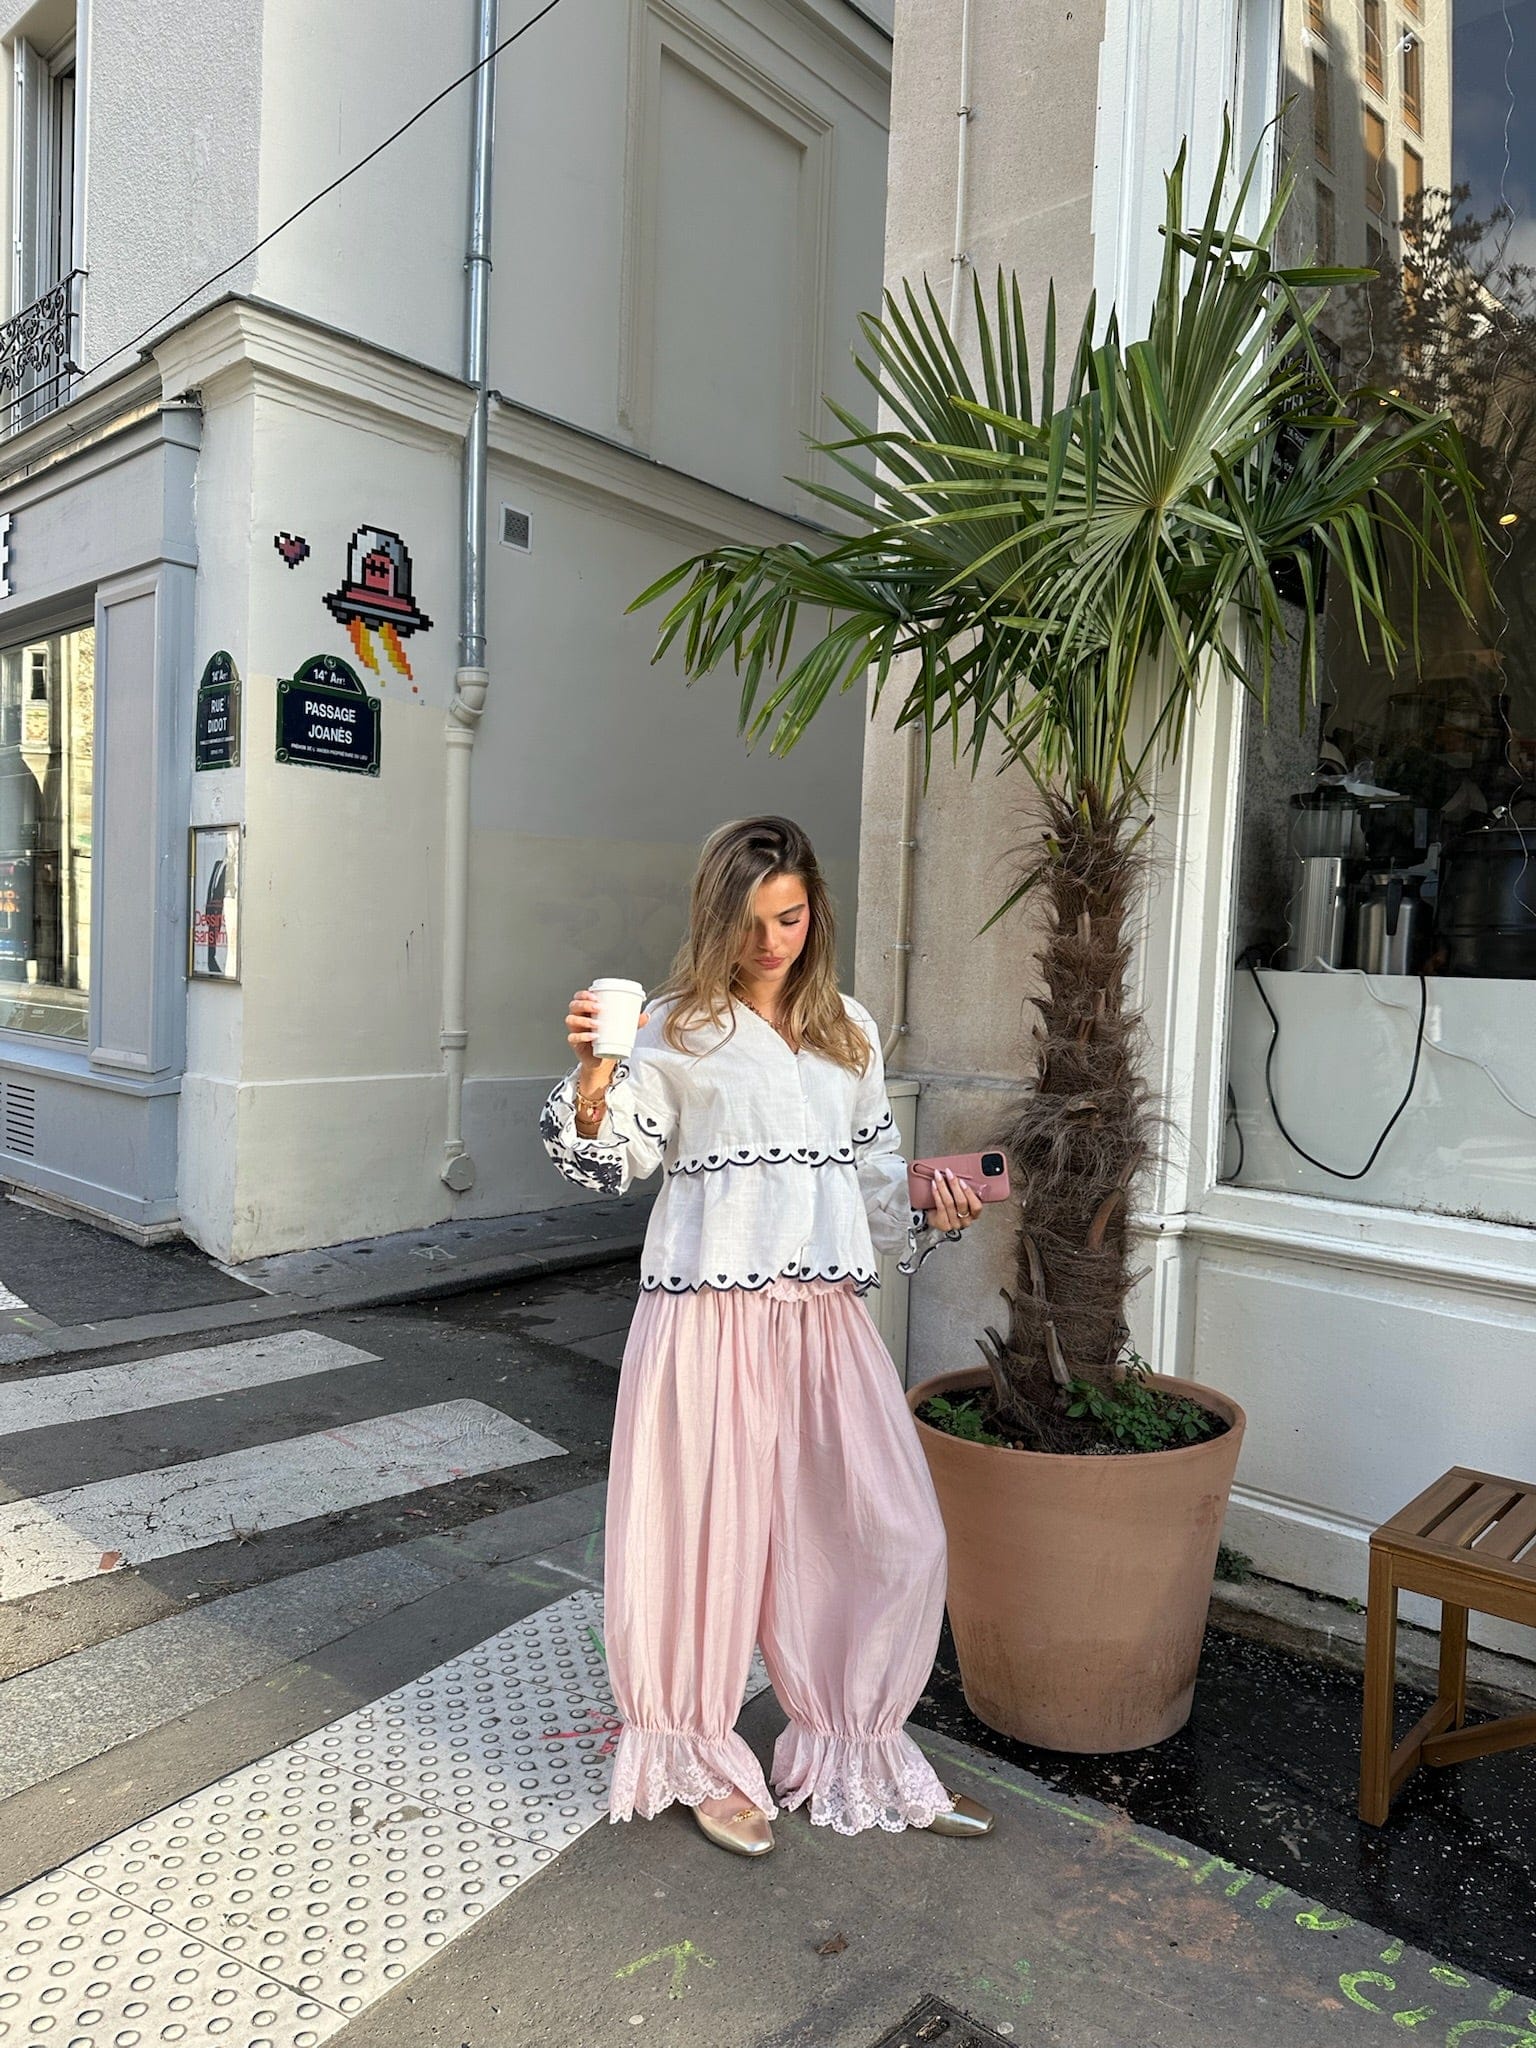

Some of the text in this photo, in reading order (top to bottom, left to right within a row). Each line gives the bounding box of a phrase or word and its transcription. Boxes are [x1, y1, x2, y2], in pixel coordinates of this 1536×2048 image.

[210, 697, 225, 713] RUE
[304, 701, 356, 724] PASSAGE
[207, 716, 228, 734] DIDOT
